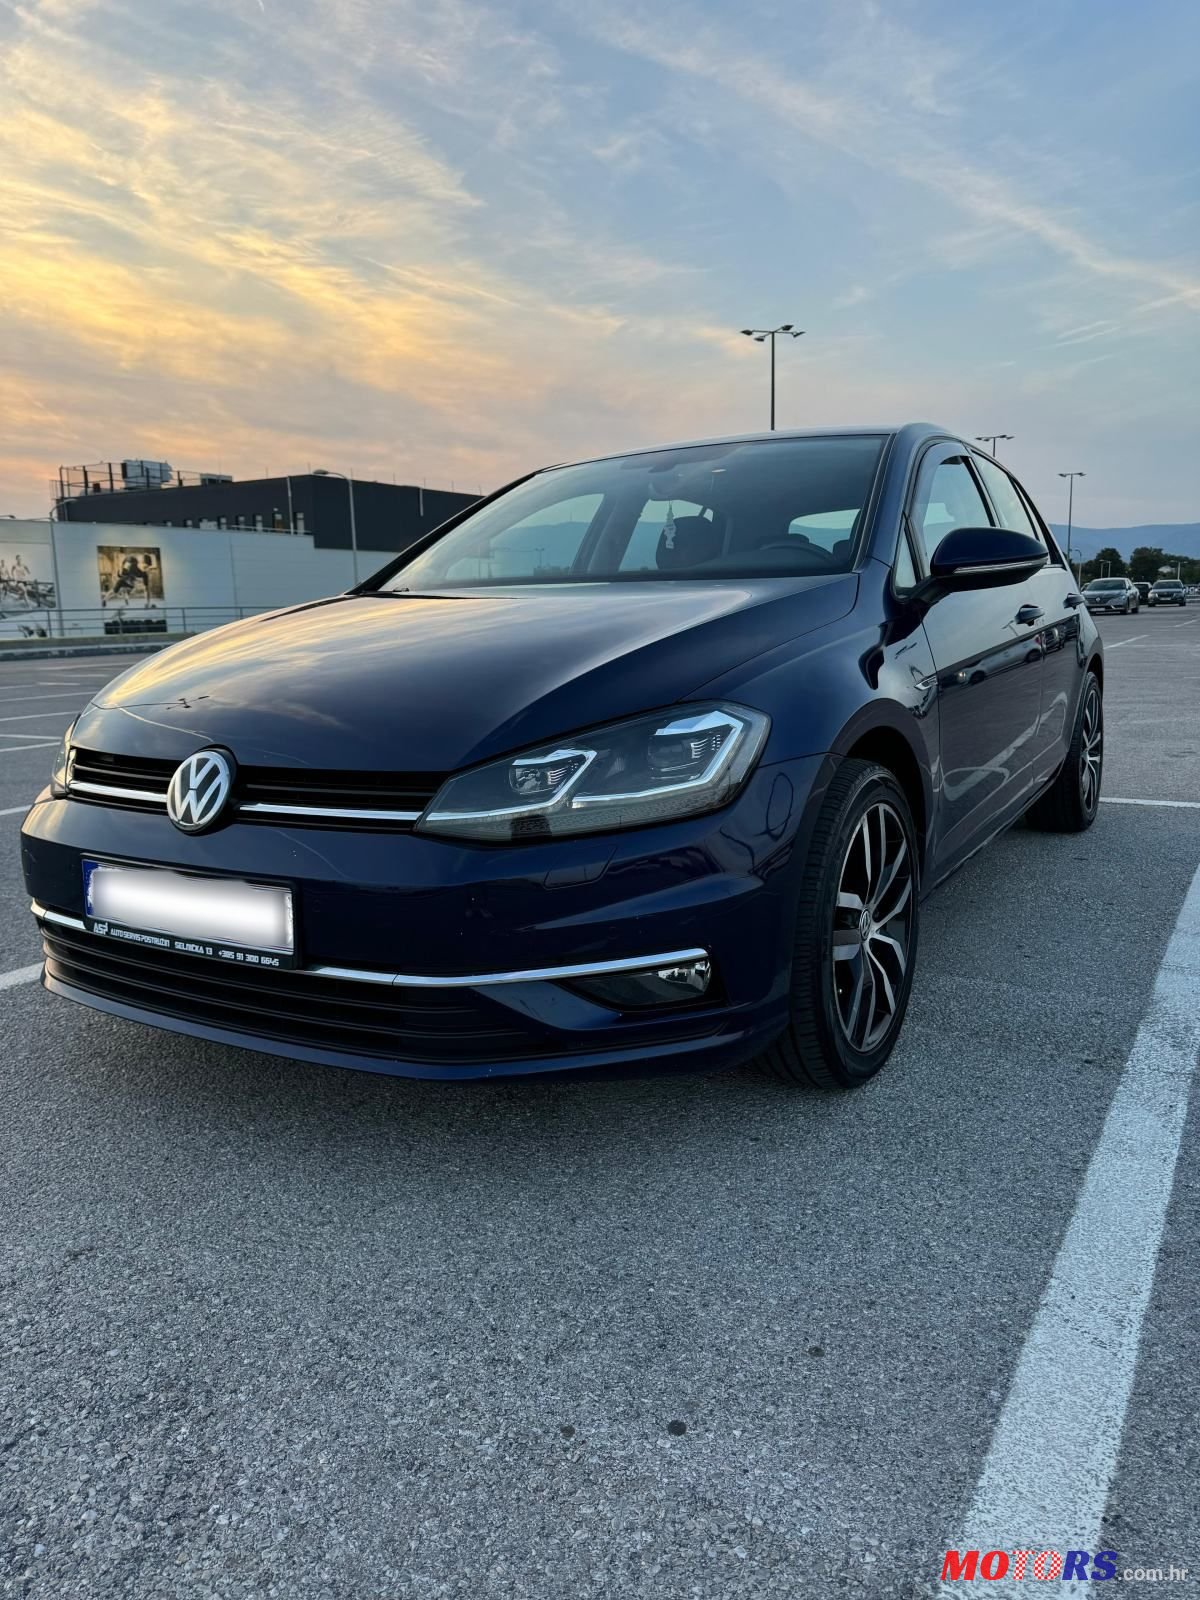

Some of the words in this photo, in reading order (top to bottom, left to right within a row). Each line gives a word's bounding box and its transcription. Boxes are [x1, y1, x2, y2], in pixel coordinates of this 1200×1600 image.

[169, 752, 228, 828] VW
[205, 947, 213, 956] 13
[218, 950, 235, 960] +385
[236, 952, 244, 961] 91
[245, 954, 259, 963] 300
